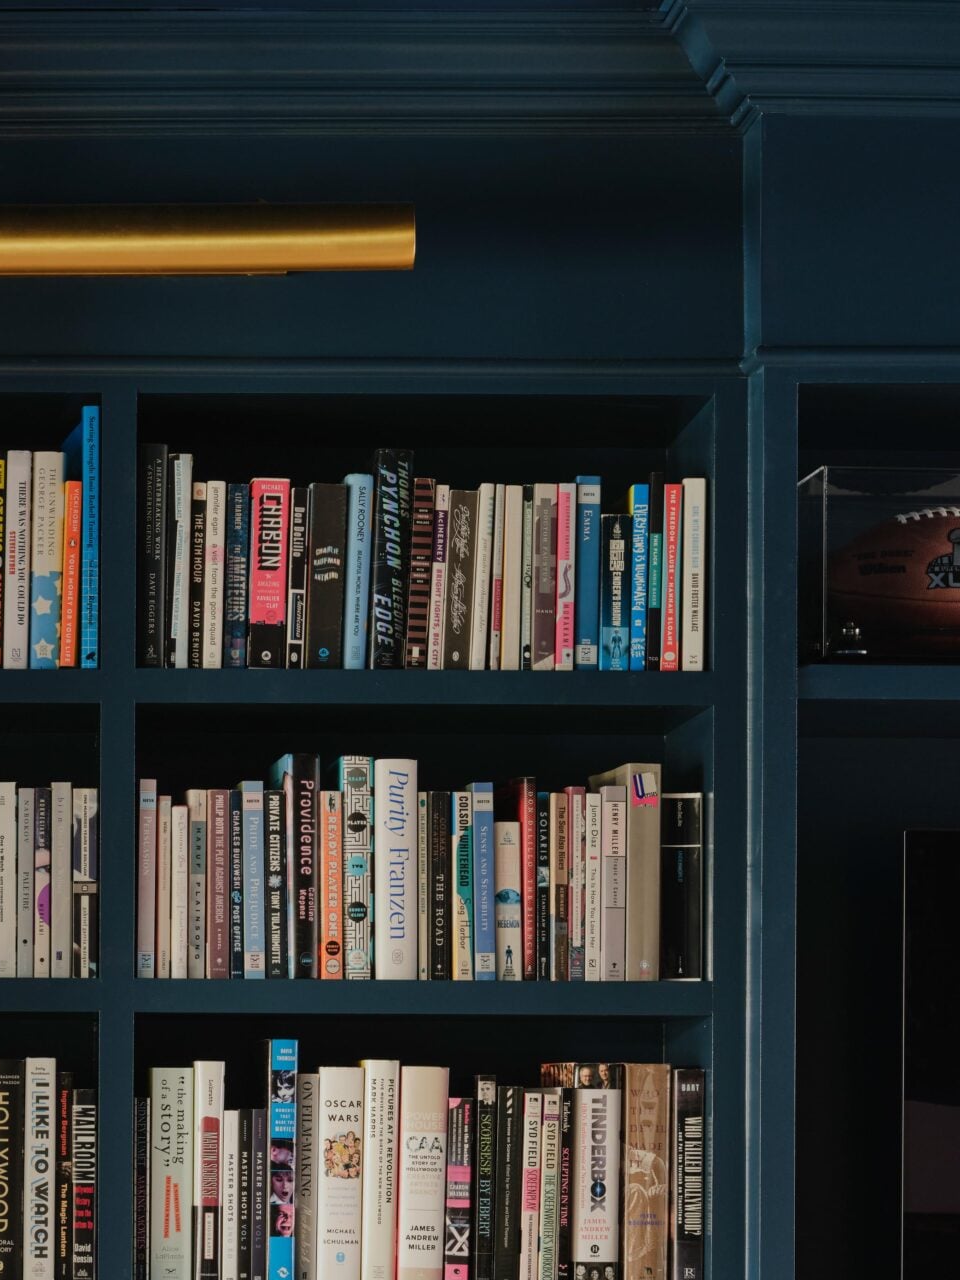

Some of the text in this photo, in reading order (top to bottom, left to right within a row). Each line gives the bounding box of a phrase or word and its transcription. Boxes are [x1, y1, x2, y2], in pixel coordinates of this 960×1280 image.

[210, 486, 220, 536] jennifer egan
[258, 492, 284, 571] CHABON
[293, 506, 306, 558] Don DeLillo
[356, 486, 367, 543] SALLY ROONEY
[380, 469, 402, 570] PYNCHON
[436, 511, 446, 562] McINERNEY
[193, 513, 204, 583] THE 25TH HOUR
[211, 567, 219, 585] from
[212, 550, 220, 565] visit
[209, 601, 217, 621] goon
[210, 587, 219, 599] the
[227, 555, 247, 622] AMATEURS
[374, 593, 394, 647] EDGE
[191, 600, 201, 668] DAVID BENIOFF
[208, 622, 218, 646] squad
[215, 795, 224, 923] PHILIP ROTH THE PLOT AGAINST AMERICA
[232, 810, 241, 889] CHARLES BUKOWSKI
[268, 795, 281, 872] PRIVATE CITIZENS
[299, 780, 316, 876] Providence
[384, 770, 410, 940] Purity Franzen
[458, 796, 469, 887] COLSON WHITEHEAD
[611, 803, 619, 855] HENRY MILLER
[327, 816, 339, 937] READY PLAYER ONE
[232, 905, 242, 952] POST OFFICE
[270, 891, 281, 964] TONY TULATHIMUTTE
[435, 874, 444, 947] THE ROAD
[35, 1095, 50, 1139] LIKE
[161, 1079, 171, 1092] of
[325, 1100, 362, 1108] OSCAR
[327, 1114, 359, 1122] WARS
[681, 1083, 700, 1091] BART
[35, 1147, 49, 1174] TO
[72, 1106, 96, 1182] MAILROOM
[172, 1109, 188, 1164] making
[301, 1081, 313, 1197] ON FILM-MAKING
[526, 1120, 538, 1210] SYD FIELD SCREENPLAY
[590, 1094, 608, 1213] TINDERBOX
[479, 1113, 492, 1237] SCORSESE BY EBERT
[684, 1116, 703, 1236] WHO KILLED HOLLYWOOD?
[34, 1181, 50, 1259] WATCH
[240, 1224, 248, 1241] VOL
